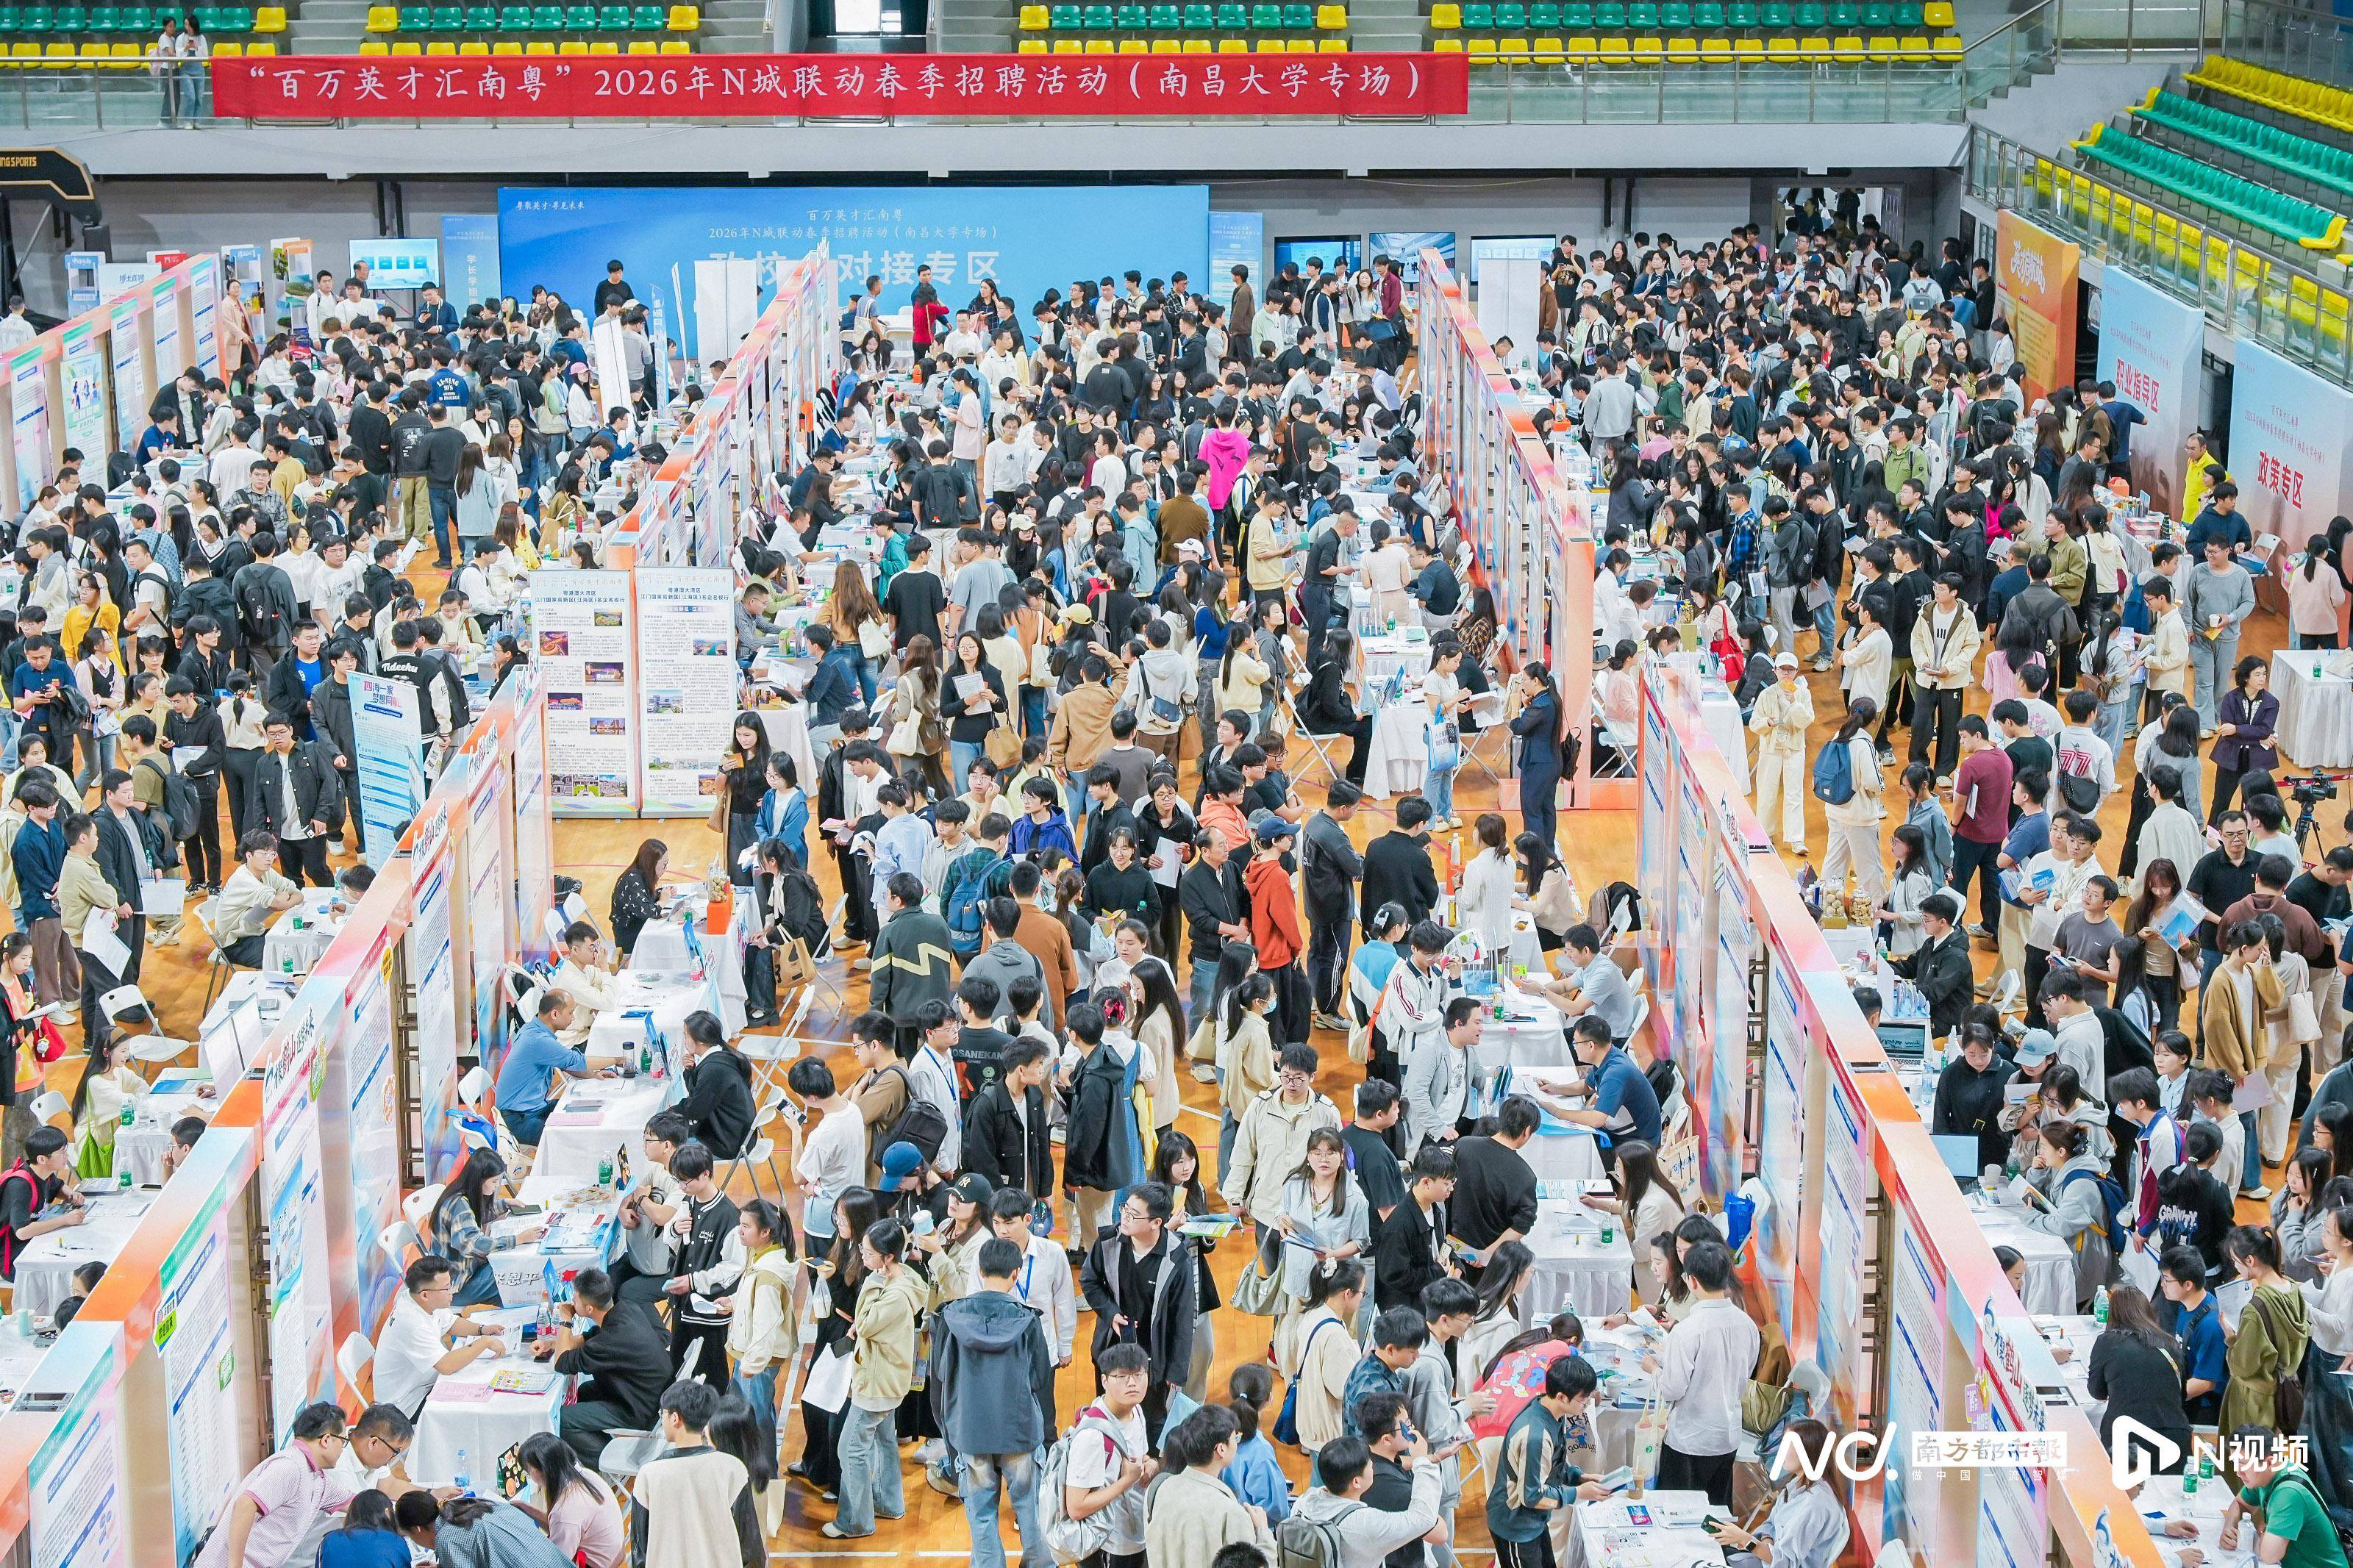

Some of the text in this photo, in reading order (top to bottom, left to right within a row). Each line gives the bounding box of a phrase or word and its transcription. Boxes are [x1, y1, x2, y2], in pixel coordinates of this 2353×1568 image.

[251, 60, 1420, 101] “百万英才汇南粤” 2026年N城联动春季招聘活动（南昌大学专场）
[806, 209, 903, 221] 百万英才汇南粤
[2115, 358, 2160, 413] 职业指导区
[2258, 451, 2304, 509] 政策专区
[363, 681, 395, 695] 四海一家
[2060, 749, 2090, 776] 77
[2158, 1204, 2198, 1229] GRAVITY
